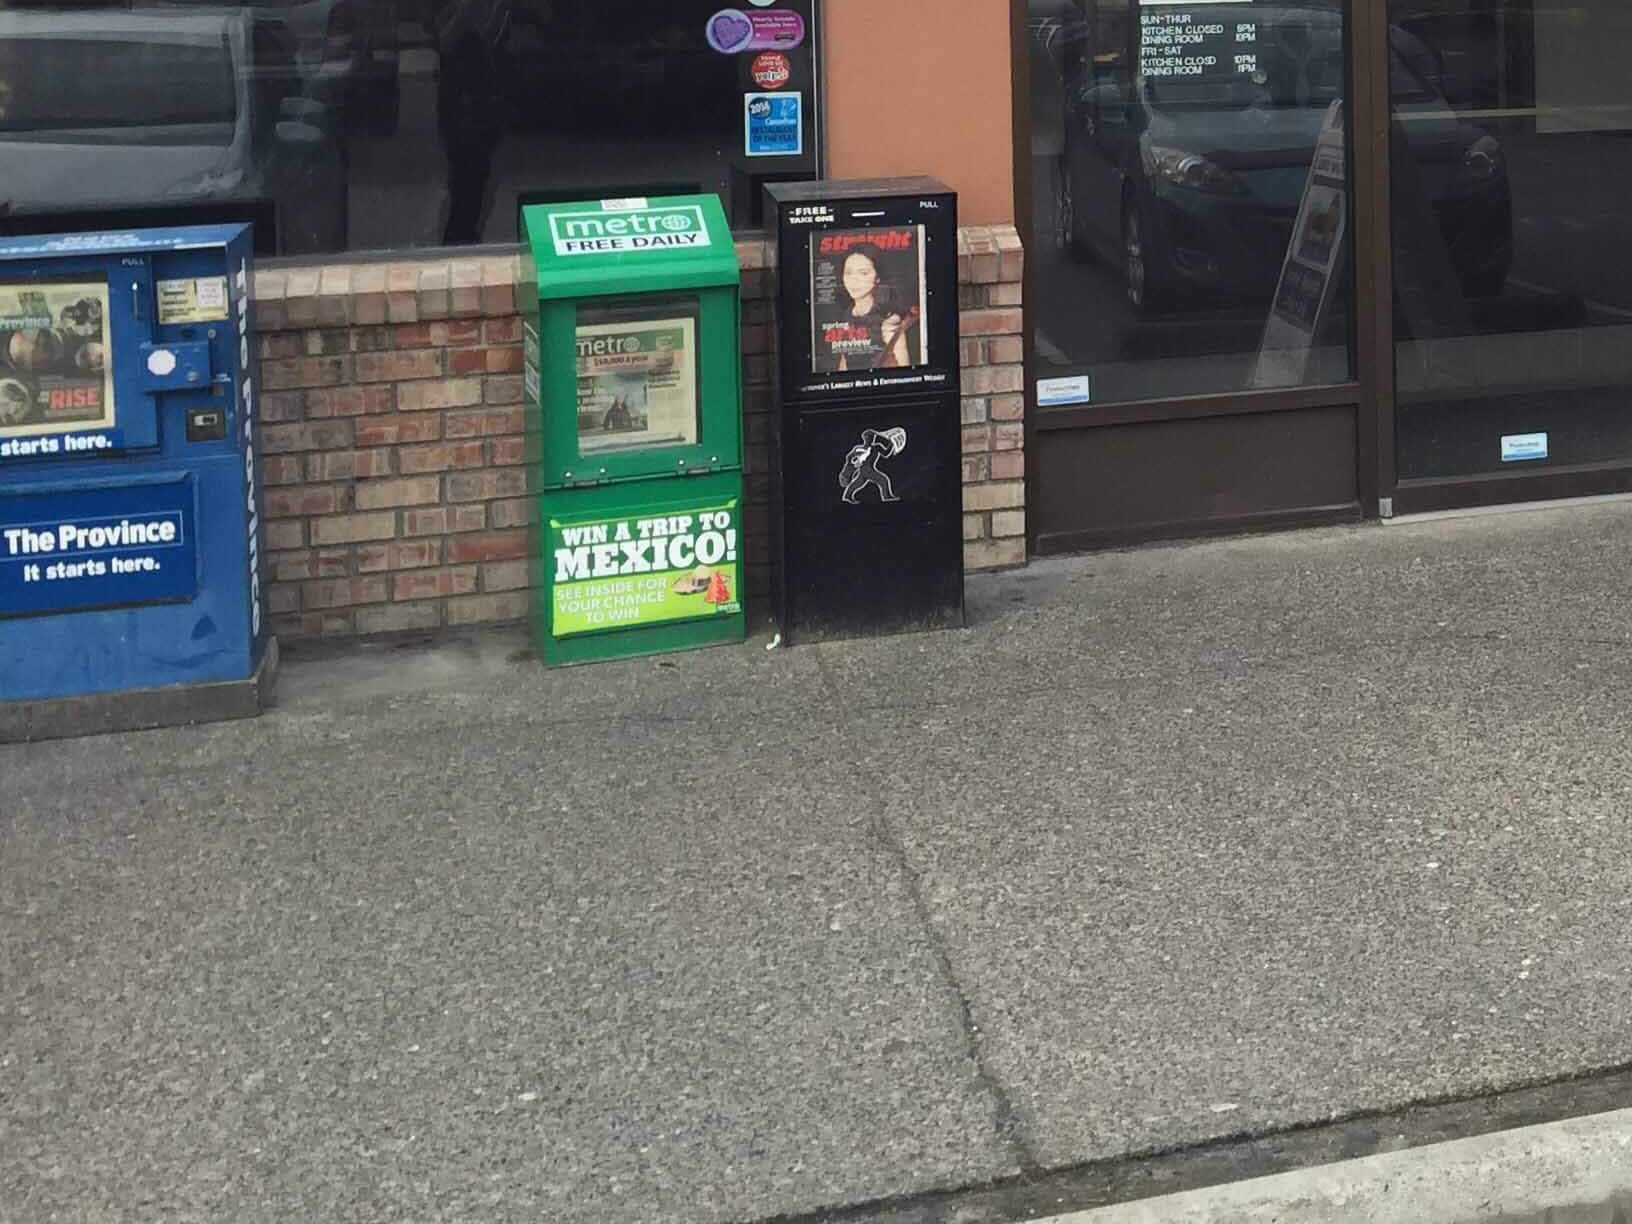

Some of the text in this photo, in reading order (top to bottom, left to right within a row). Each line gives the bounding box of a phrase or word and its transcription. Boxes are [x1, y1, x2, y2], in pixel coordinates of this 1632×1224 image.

[1142, 25, 1182, 36] KITCHEN
[1185, 24, 1224, 34] CLOSED
[1142, 35, 1172, 45] DINING
[1175, 34, 1203, 44] ROOM
[1141, 56, 1182, 67] KITCHEN
[1142, 66, 1172, 76] DINING
[1174, 65, 1202, 75] ROOM
[919, 200, 938, 209] PULL
[565, 213, 692, 237] metro
[790, 215, 834, 224] TAKE ONE
[566, 233, 697, 252] FREE DAILY
[50, 386, 98, 409] RISE
[0, 434, 112, 456] starts here.
[4, 520, 175, 554] The Province
[562, 511, 730, 547] WIN A TRIP TO
[554, 528, 737, 582] MEXICO!
[24, 556, 160, 582] It starts here.
[557, 577, 667, 601] SEE INSIDE FOR
[559, 590, 665, 613] YOUR CHANCE
[585, 605, 640, 624] TO WIN
